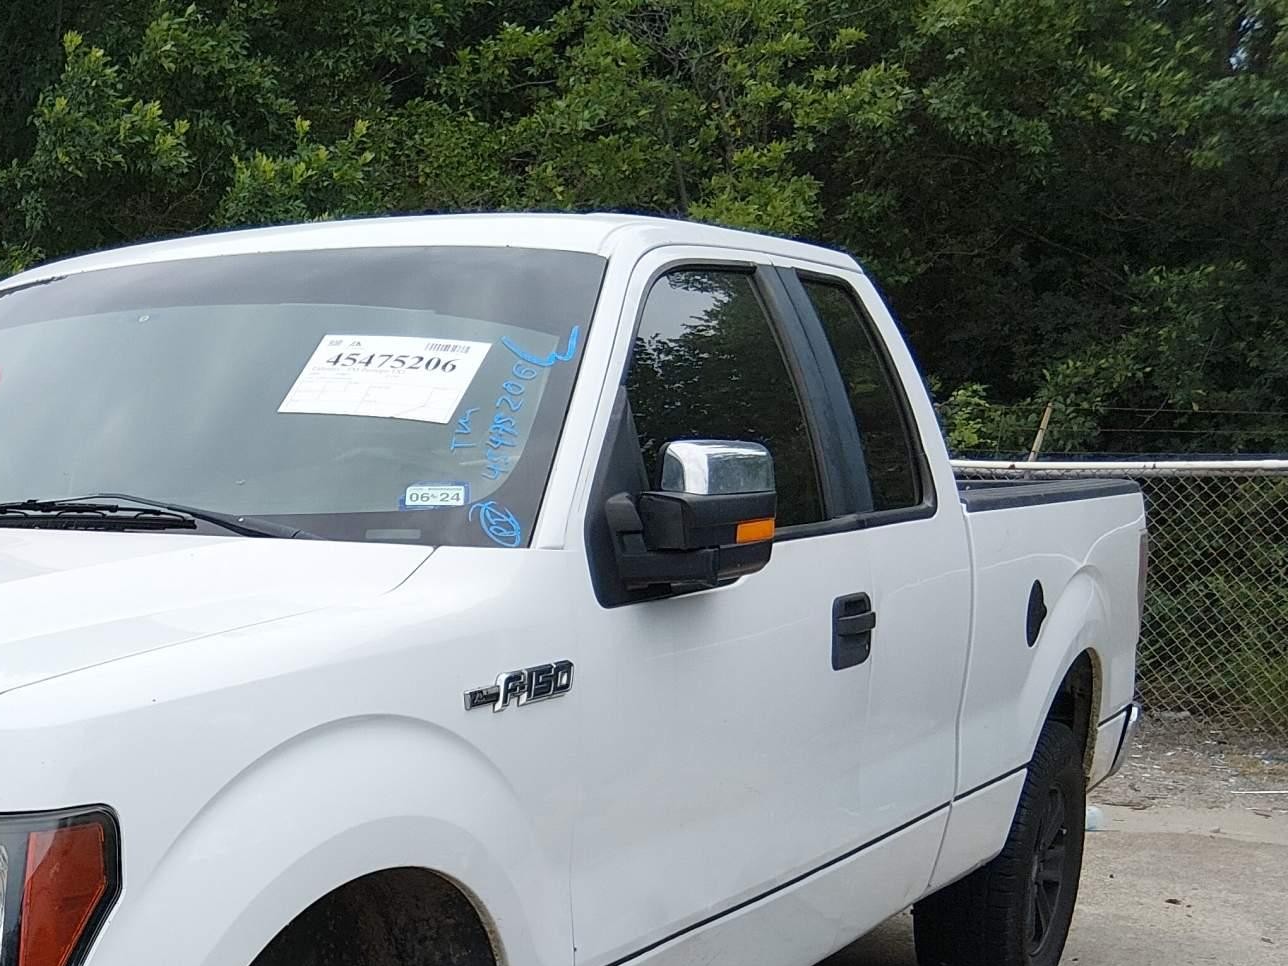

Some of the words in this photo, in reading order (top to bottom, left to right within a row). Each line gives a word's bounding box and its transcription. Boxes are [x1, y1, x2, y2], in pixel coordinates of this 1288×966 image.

[326, 352, 462, 373] 45475206
[409, 492, 431, 503] 06
[438, 492, 461, 503] 24
